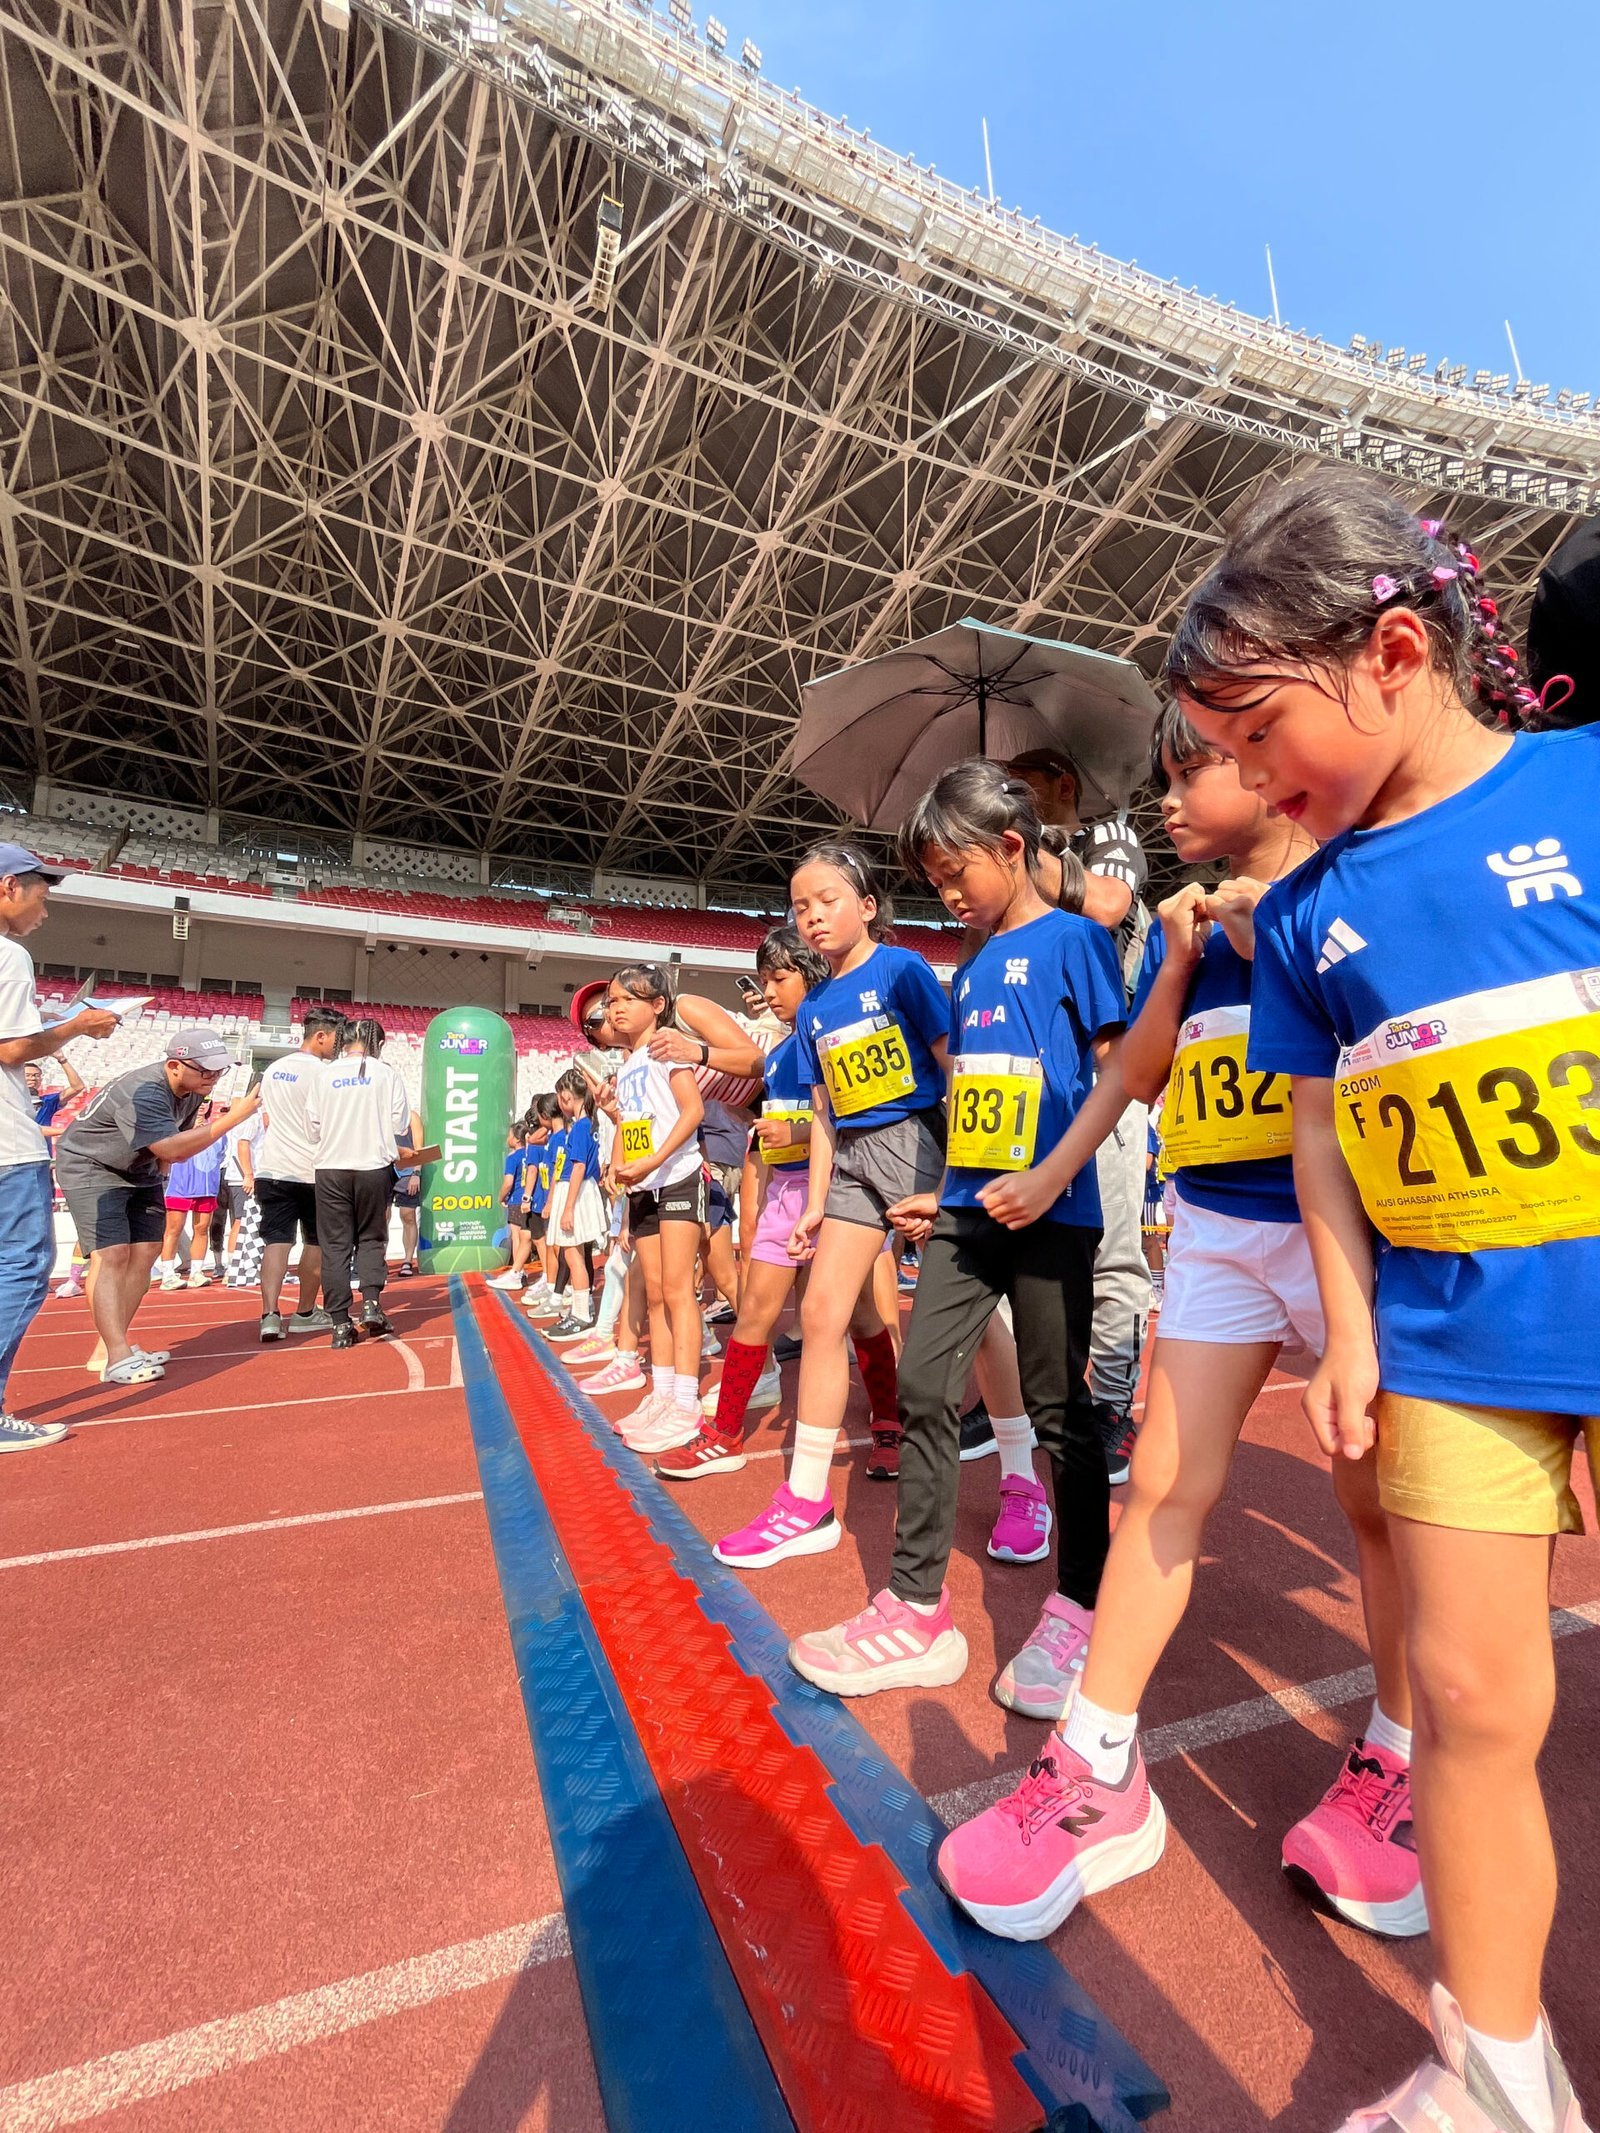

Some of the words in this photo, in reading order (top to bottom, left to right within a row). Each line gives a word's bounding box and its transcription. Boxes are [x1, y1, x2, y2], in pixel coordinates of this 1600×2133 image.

[385, 845, 439, 859] SEKTOR
[1386, 1020, 1447, 1049] JUNIOR
[1389, 1021, 1412, 1033] Taro
[287, 1036, 300, 1044] 29
[439, 1038, 488, 1050] JUNIOR
[1413, 1036, 1441, 1050] DASH
[827, 1037, 906, 1092] 21335
[272, 1071, 299, 1083] CREW
[332, 1076, 372, 1089] CREW
[1175, 1056, 1293, 1126] 2132
[1340, 1075, 1382, 1097] 200M
[443, 1066, 479, 1184] START
[1349, 1101, 1367, 1139] F
[1013, 1146, 1021, 1156] 8
[432, 1195, 492, 1211] 200M
[1397, 1193, 1446, 1206] GHASSANI
[1448, 1186, 1501, 1200] ATHSIRA
